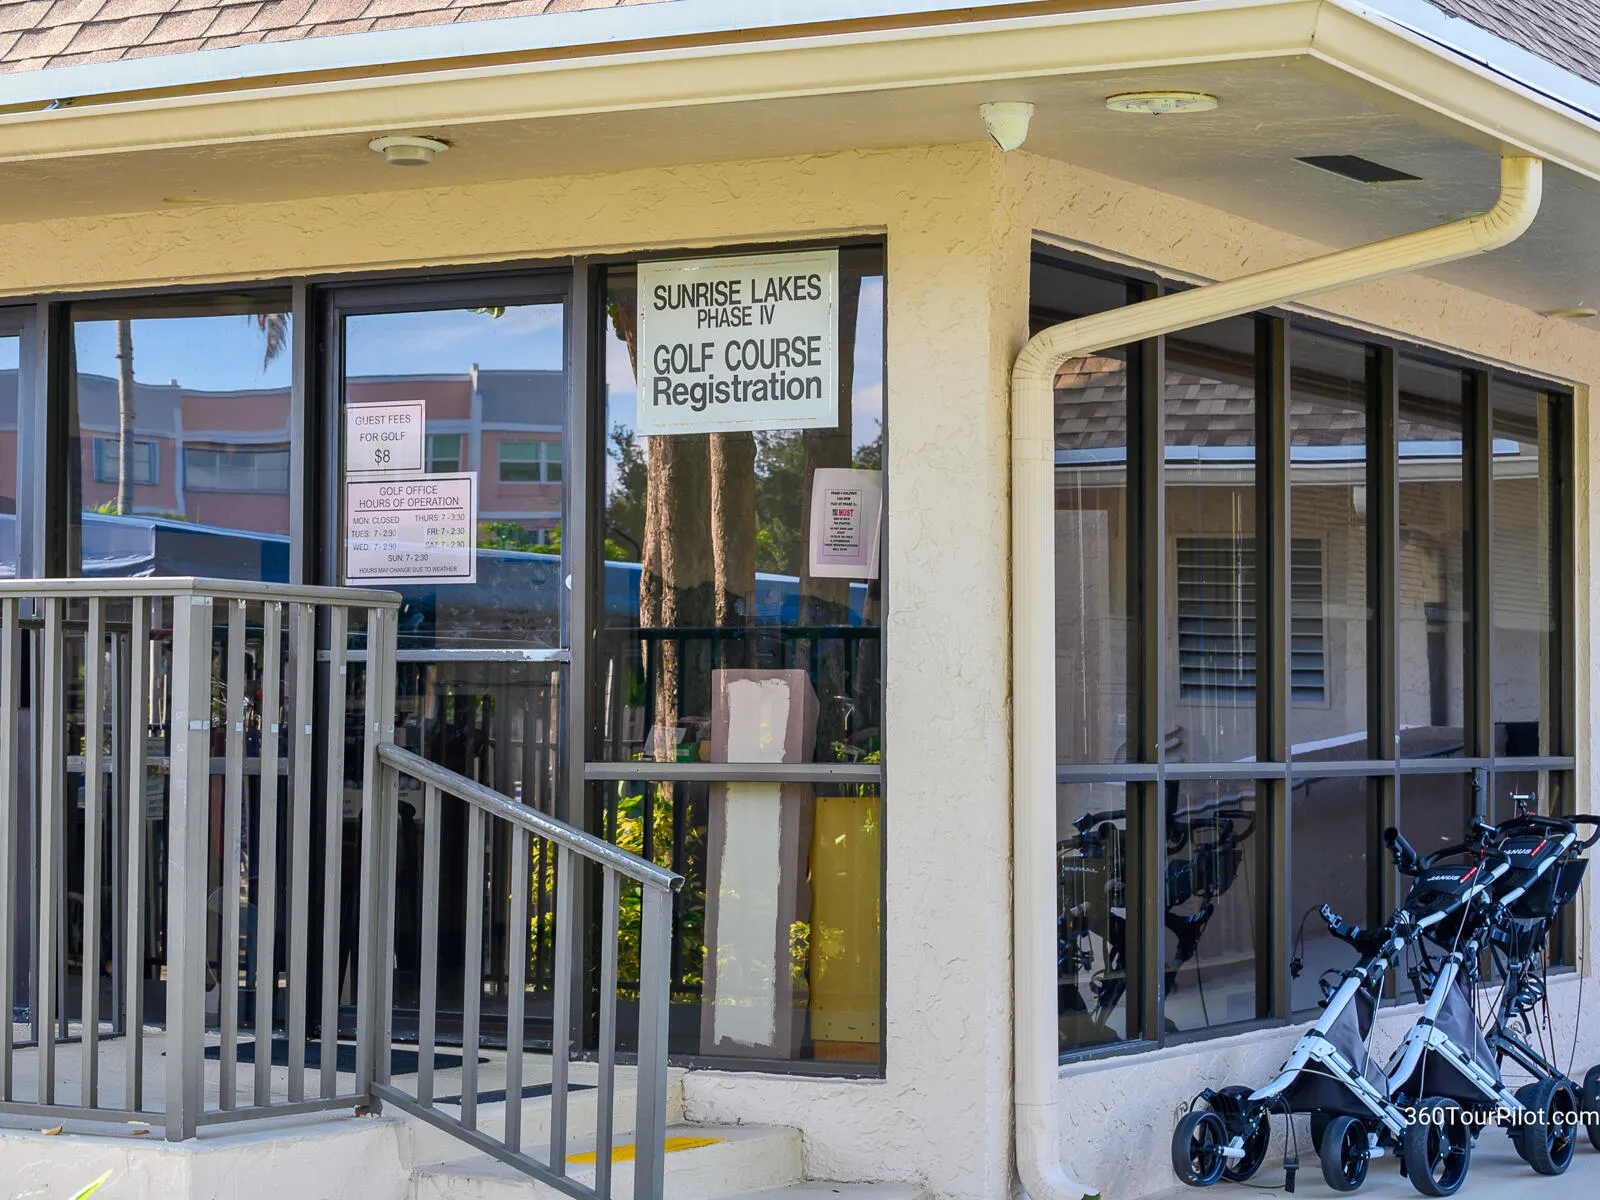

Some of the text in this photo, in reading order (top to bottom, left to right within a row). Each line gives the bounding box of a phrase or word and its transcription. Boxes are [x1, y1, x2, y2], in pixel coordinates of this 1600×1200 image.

[653, 273, 822, 311] SUNRISE LAKES
[697, 304, 775, 329] PHASE IV
[653, 335, 822, 376] GOLF COURSE
[653, 371, 822, 412] Registration
[355, 414, 411, 425] GUEST FEES
[360, 432, 406, 442] FOR GOLF
[374, 448, 390, 466] $8
[379, 485, 438, 496] GOLF OFFICE
[359, 496, 459, 508] HOURS OF OPERATION
[838, 509, 854, 517] MUST
[372, 516, 400, 524] CLOSED
